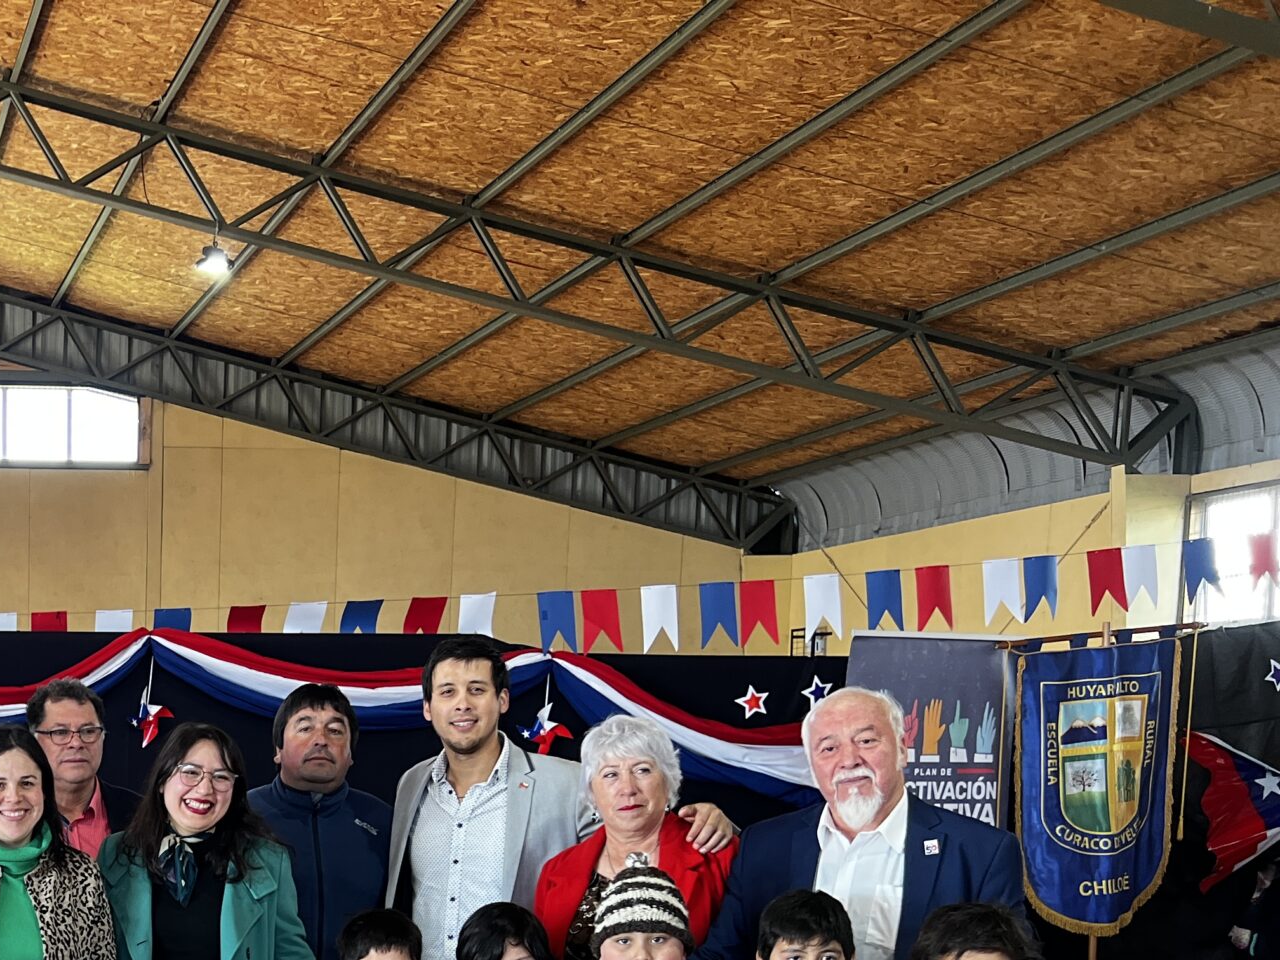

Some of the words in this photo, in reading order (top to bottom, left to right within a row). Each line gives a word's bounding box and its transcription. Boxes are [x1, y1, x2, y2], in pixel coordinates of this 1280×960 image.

[1046, 722, 1058, 786] ESCUELA
[1143, 720, 1155, 768] RURAL
[914, 767, 937, 776] PLAN
[940, 767, 952, 776] DE
[904, 776, 997, 800] CTIVACIÓN
[1055, 824, 1112, 850] CURACO
[1078, 872, 1130, 897] CHILOÉ
